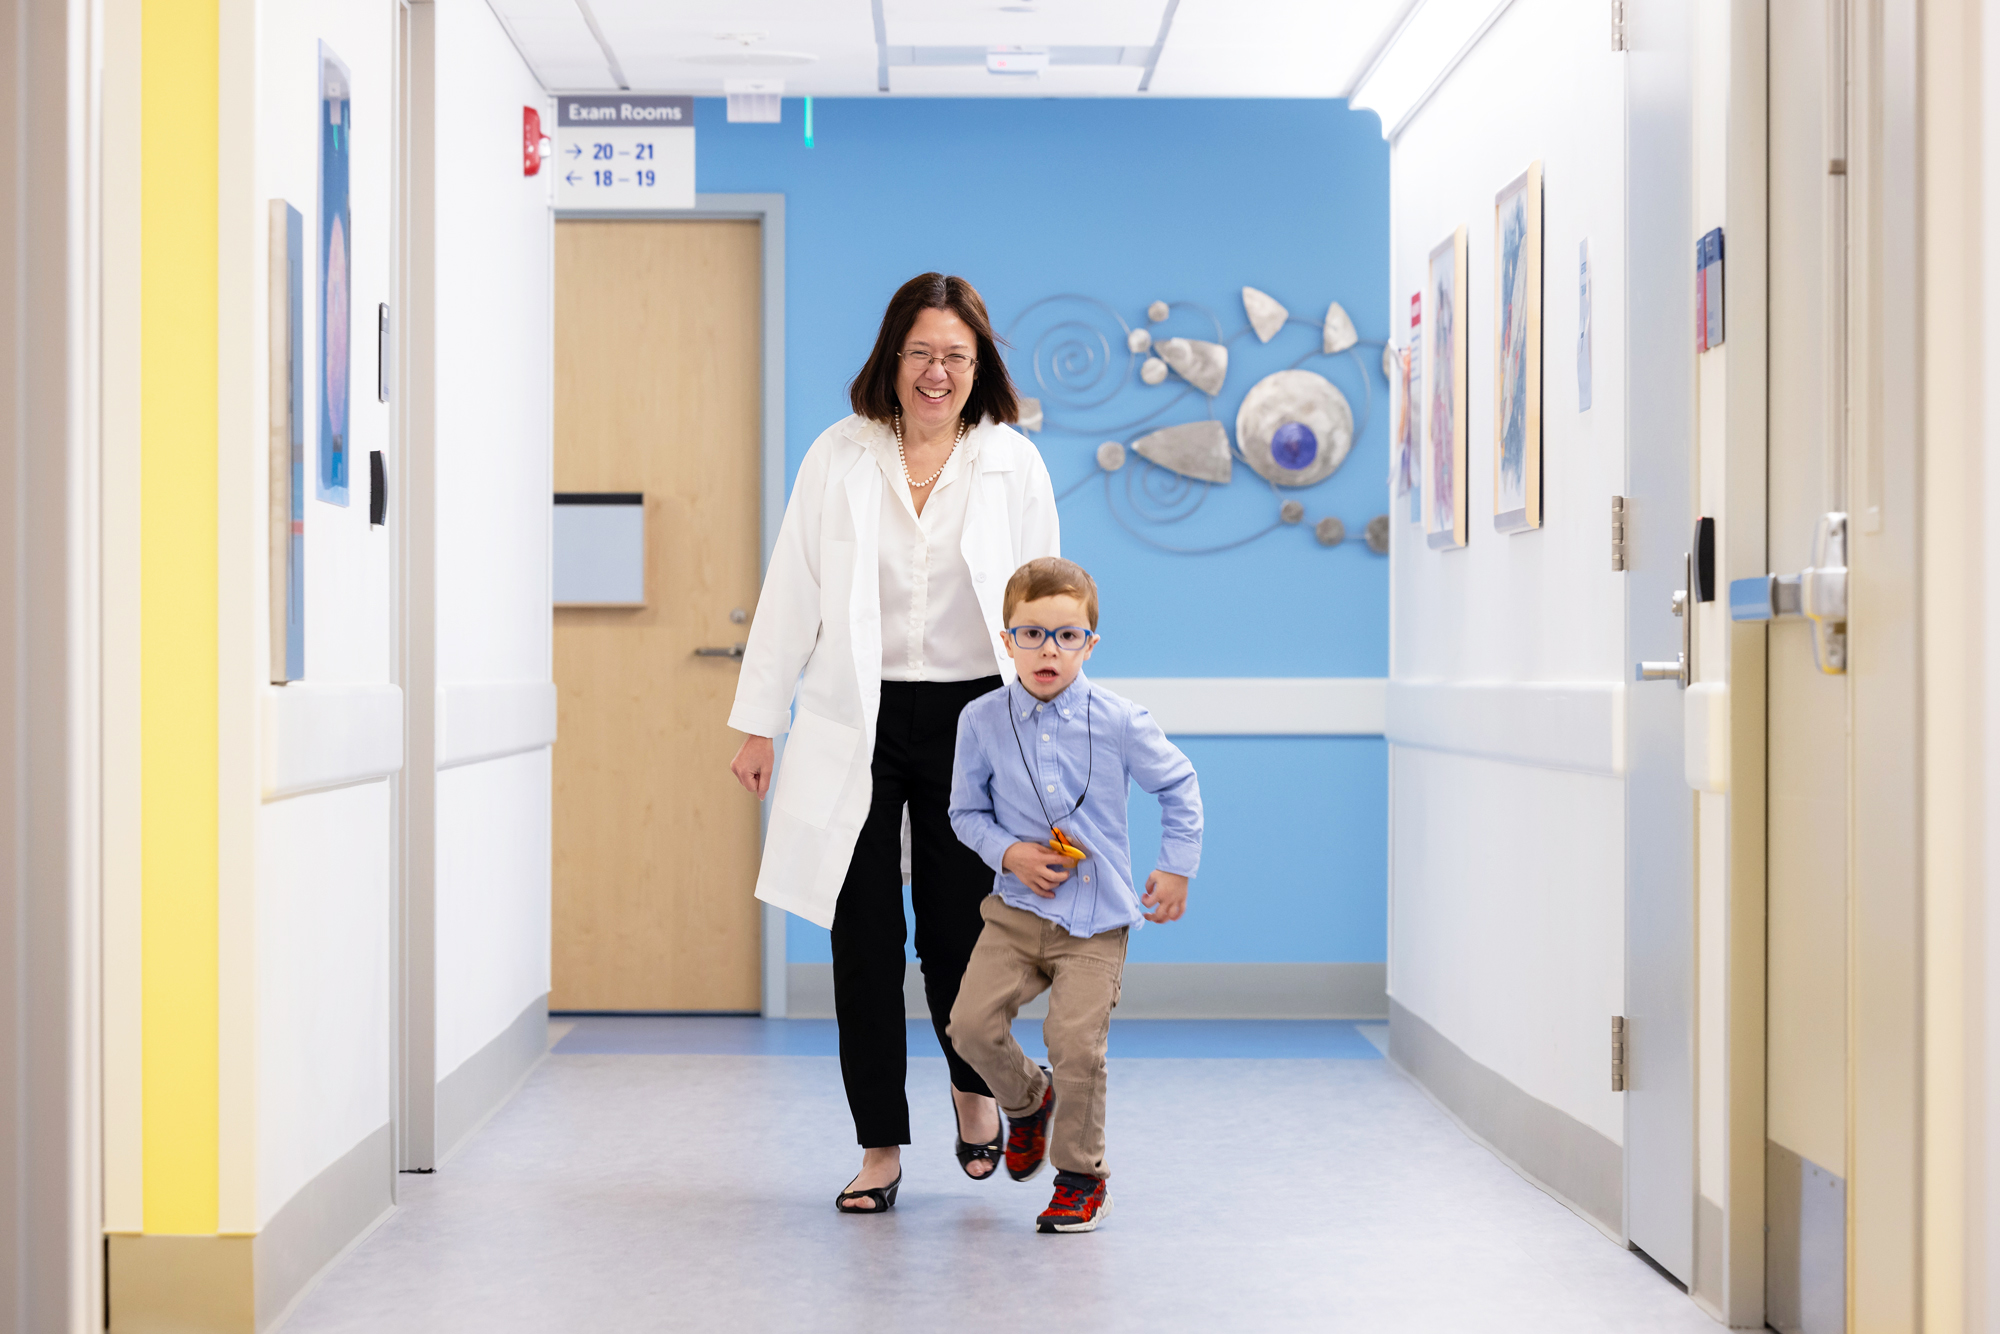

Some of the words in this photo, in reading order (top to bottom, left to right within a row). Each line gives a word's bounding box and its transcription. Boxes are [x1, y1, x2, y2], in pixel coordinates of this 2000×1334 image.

[568, 103, 616, 121] Exam
[620, 103, 682, 121] Rooms
[593, 143, 614, 160] 20
[635, 143, 654, 160] 21
[593, 170, 613, 187] 18
[636, 170, 656, 187] 19
